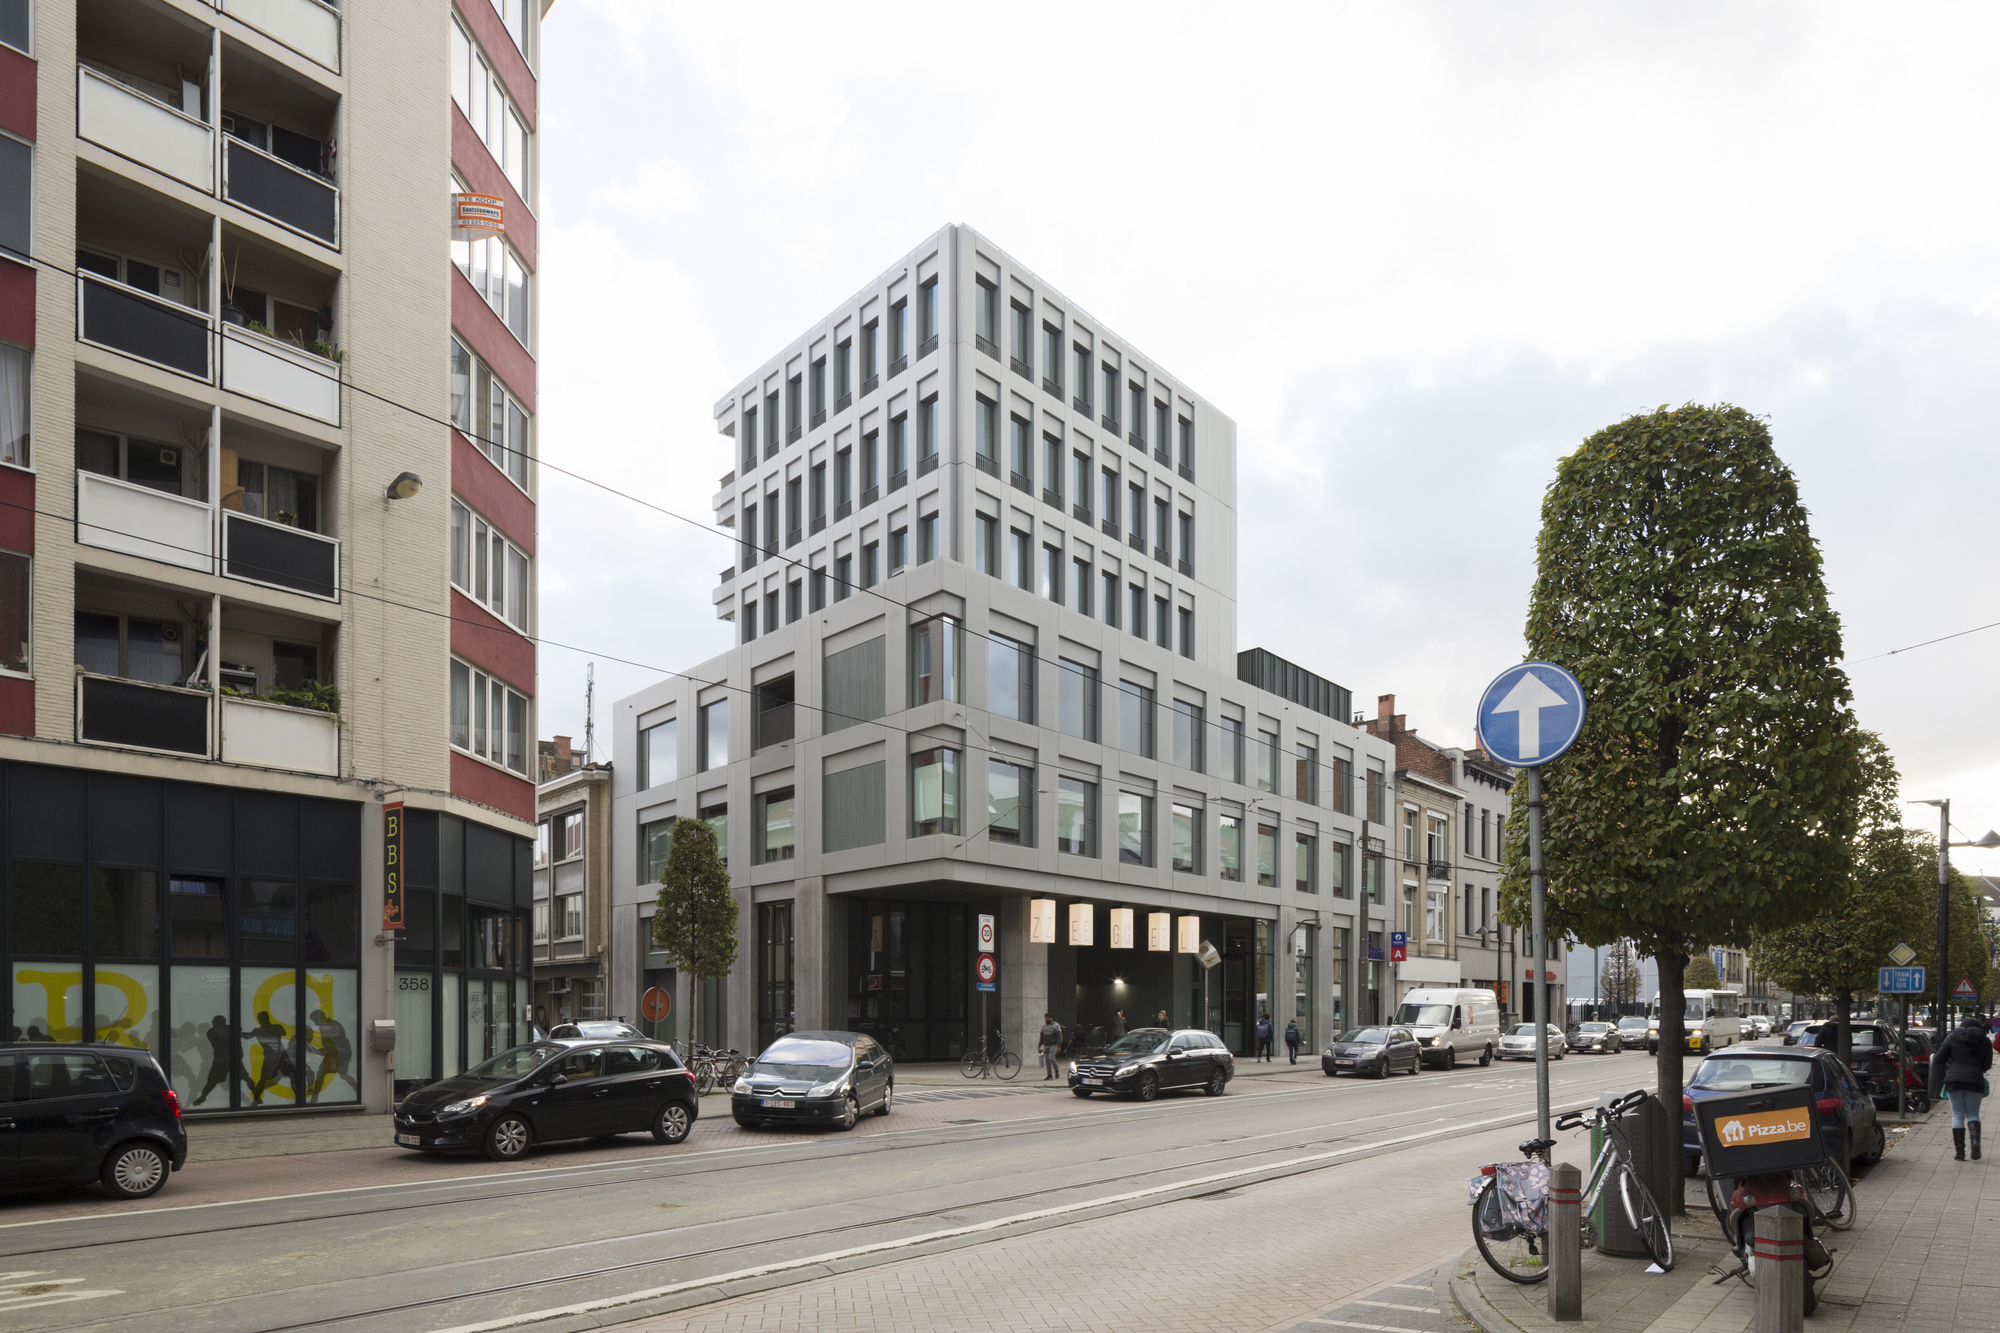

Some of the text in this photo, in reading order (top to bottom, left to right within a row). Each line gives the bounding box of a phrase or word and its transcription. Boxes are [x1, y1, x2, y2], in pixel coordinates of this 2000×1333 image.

[387, 816, 398, 894] BBS
[983, 929, 990, 937] 30
[1394, 949, 1402, 958] A
[399, 977, 429, 990] 358
[1748, 1120, 1807, 1137] Pizza.be
